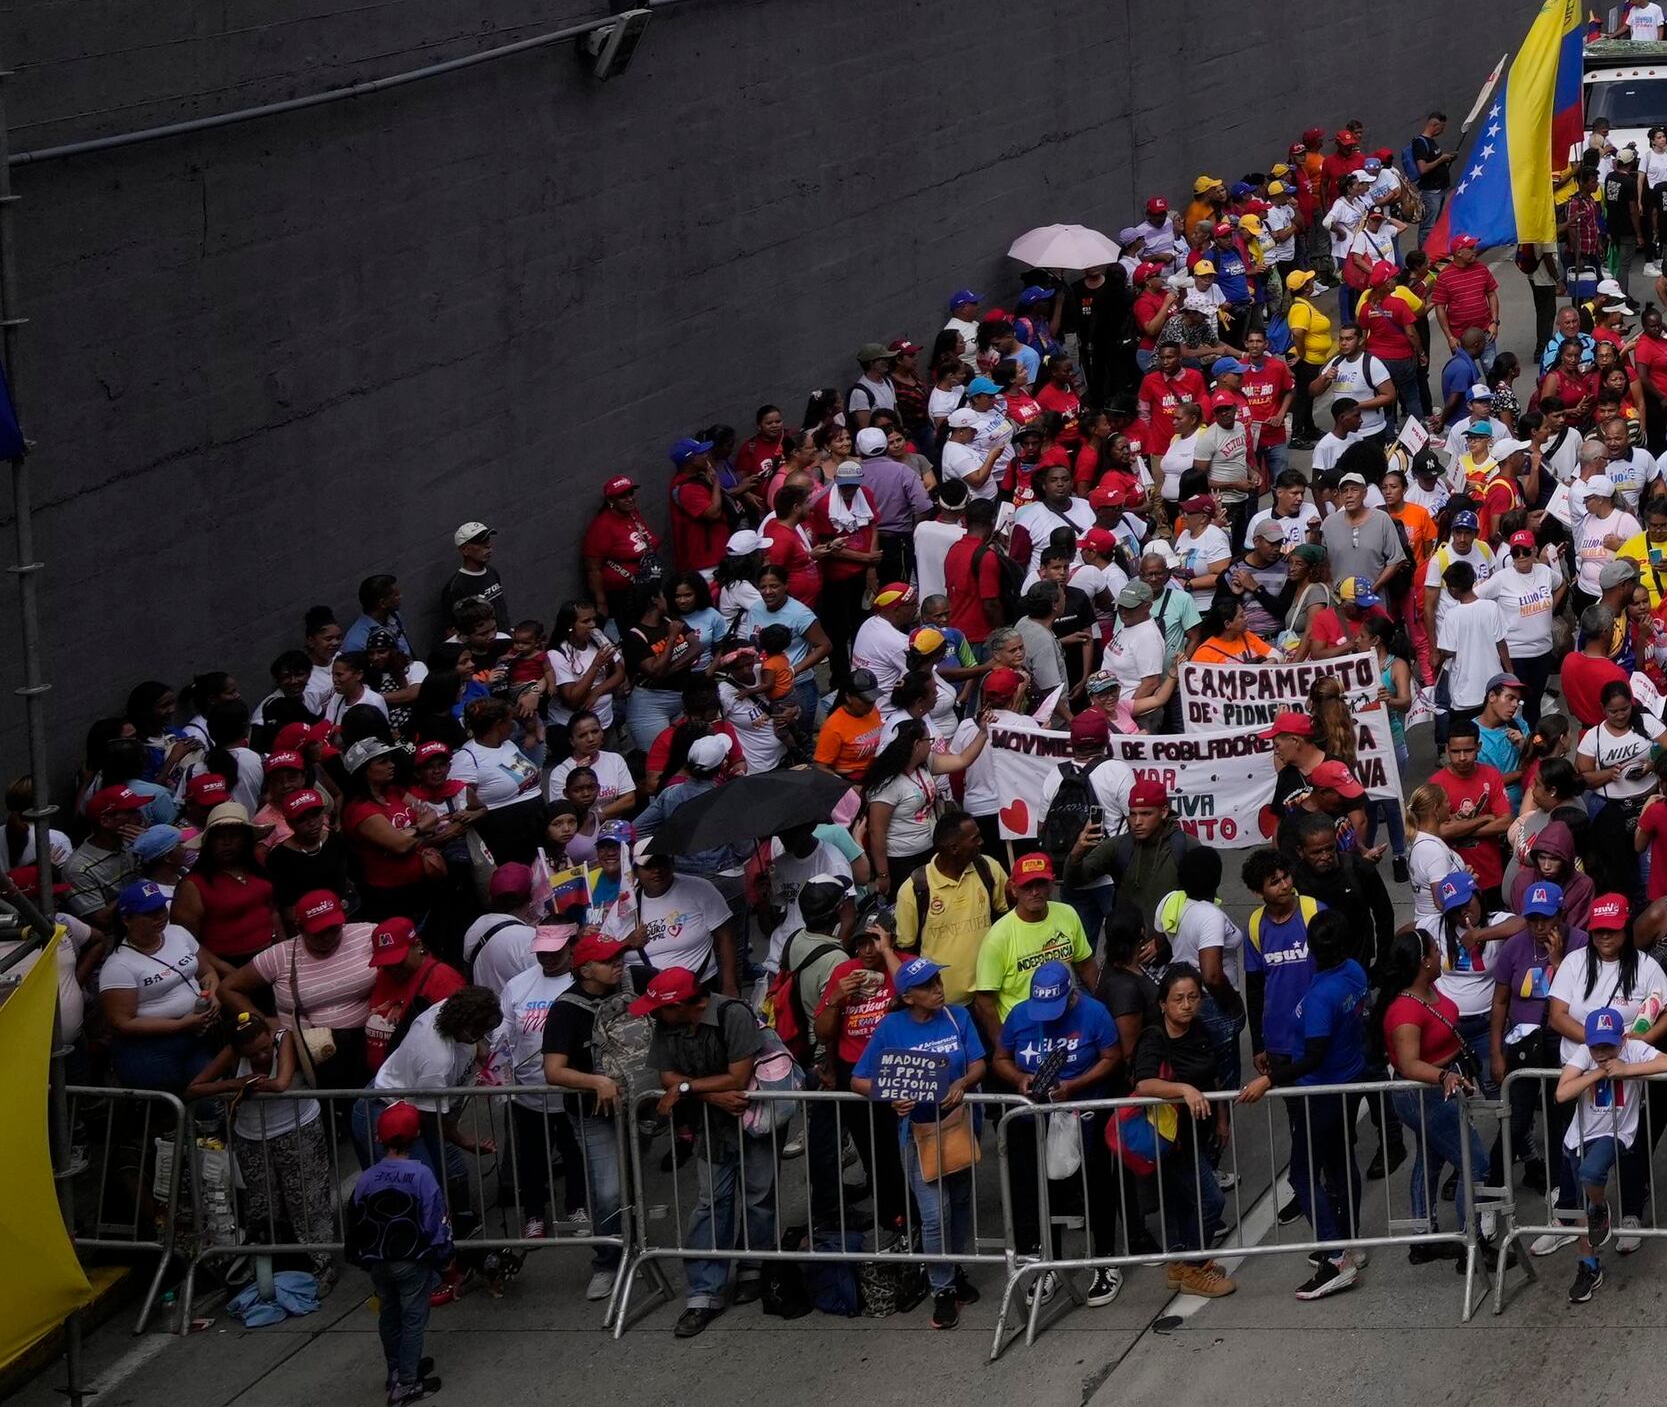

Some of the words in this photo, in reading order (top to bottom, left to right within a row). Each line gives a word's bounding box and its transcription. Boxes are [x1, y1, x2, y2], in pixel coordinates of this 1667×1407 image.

[1184, 658, 1374, 699] CAMPAMENTO
[1188, 702, 1213, 723] DE
[1121, 741, 1147, 760] DE
[1153, 734, 1275, 760] POBLADORE
[1606, 744, 1640, 761] NIKE
[896, 1067, 922, 1077] PPT
